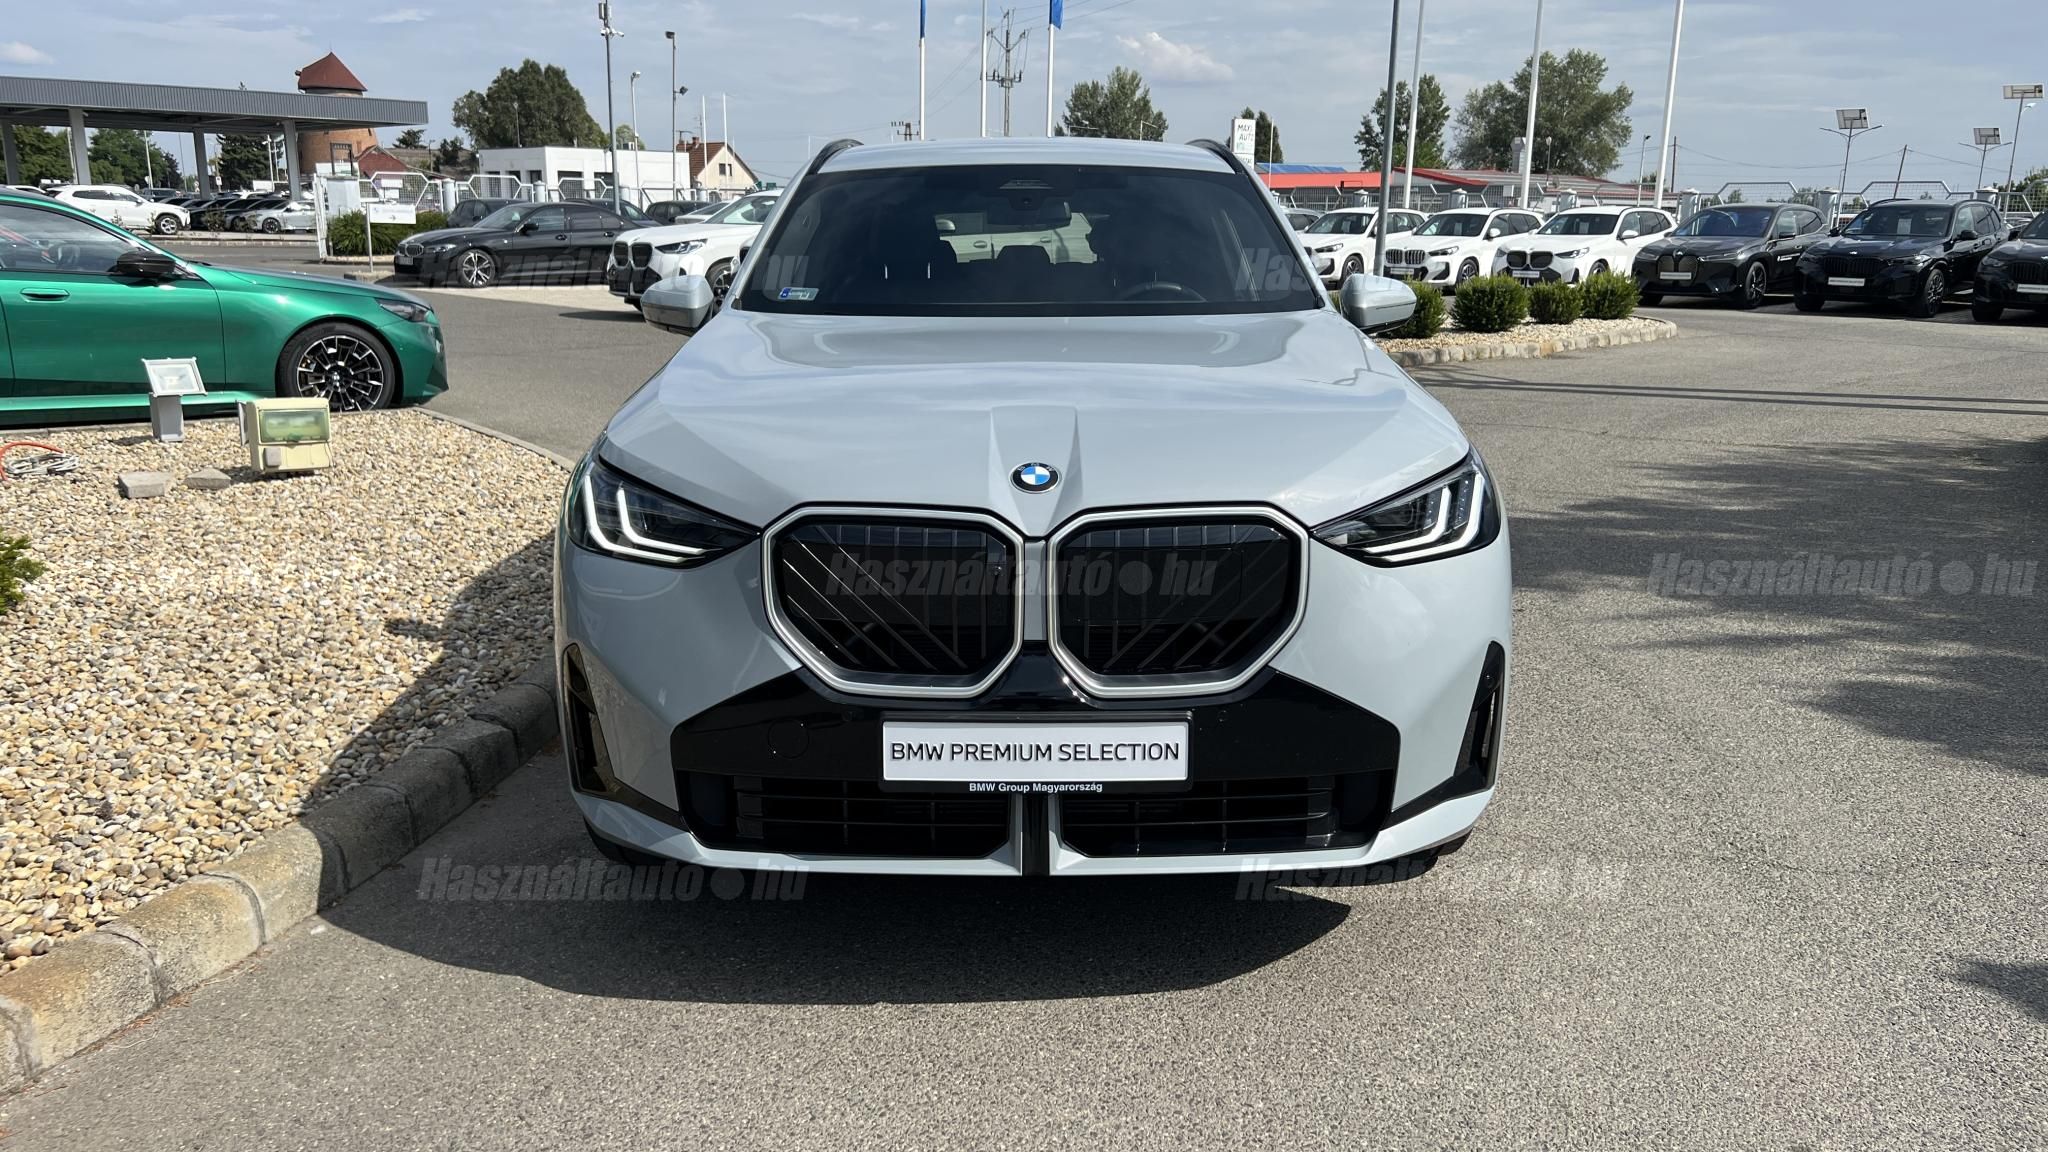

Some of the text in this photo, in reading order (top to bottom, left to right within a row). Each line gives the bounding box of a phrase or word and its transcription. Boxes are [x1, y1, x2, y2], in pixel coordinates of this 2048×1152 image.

[891, 742, 1180, 762] BMW PREMIUM SELECTION
[969, 782, 1104, 794] BMW Group Magyarország
